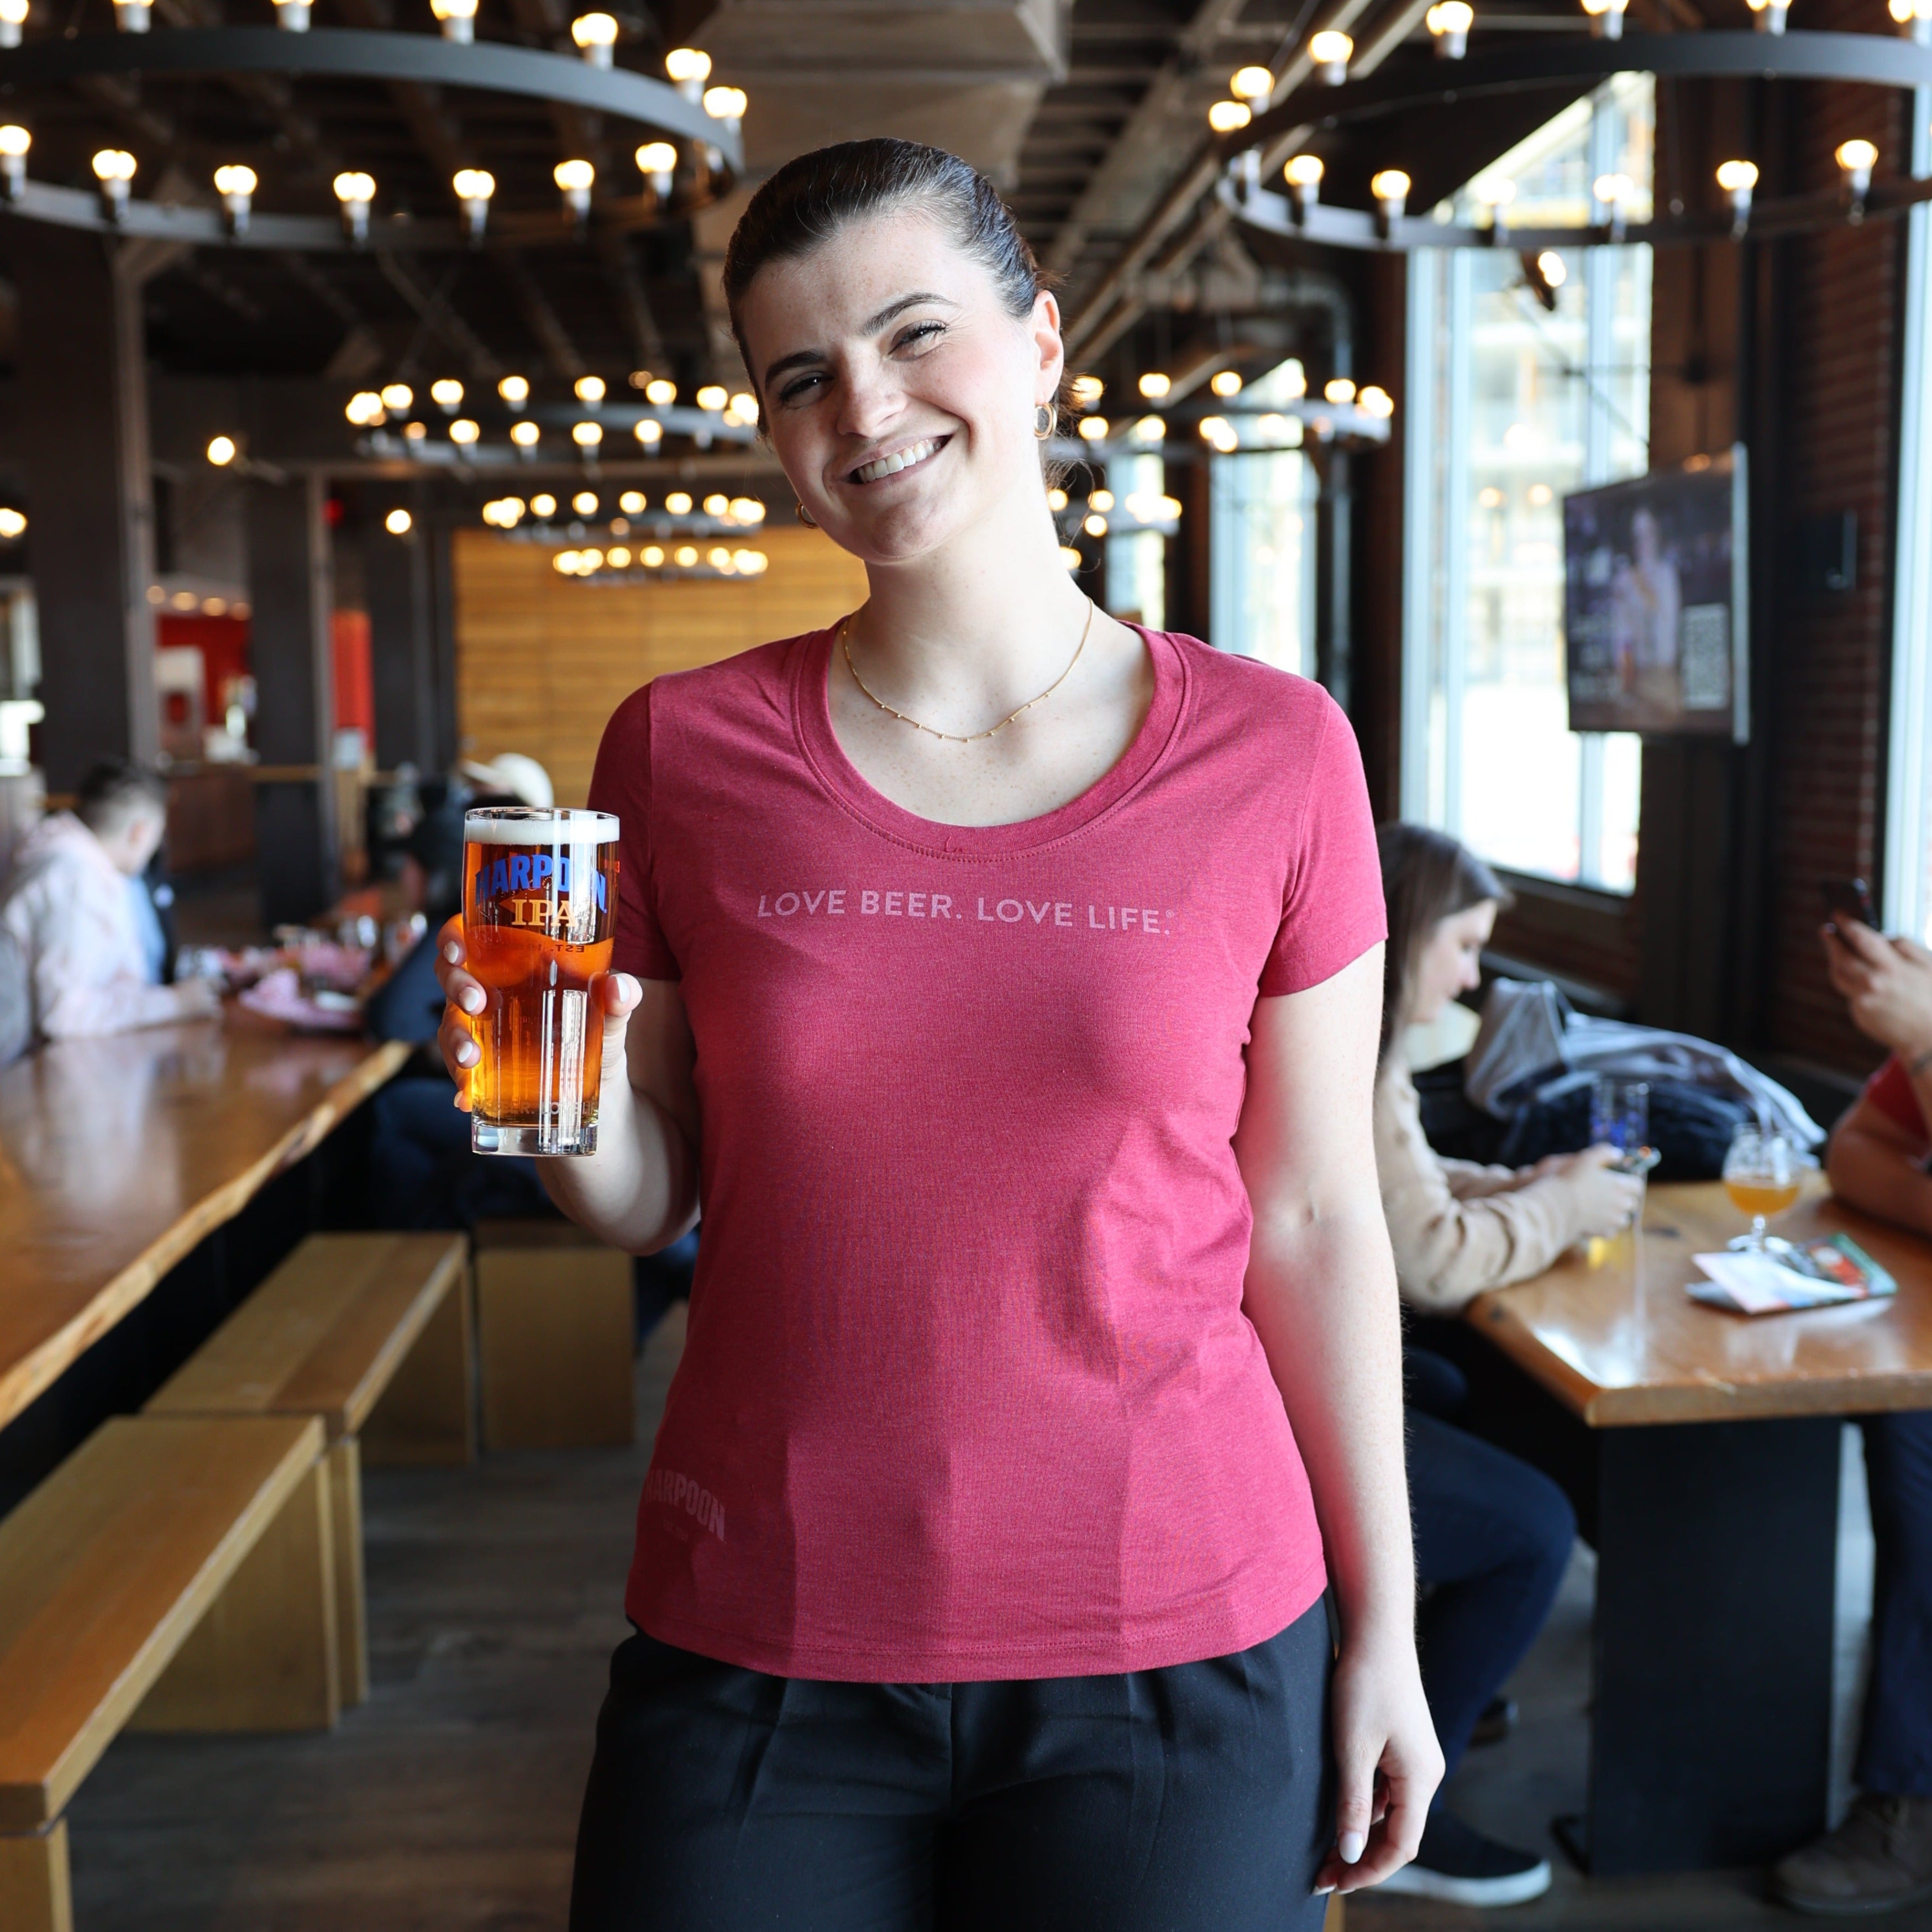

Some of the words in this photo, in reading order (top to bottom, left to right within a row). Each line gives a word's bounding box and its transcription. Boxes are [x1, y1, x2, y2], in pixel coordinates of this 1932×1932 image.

[475, 854, 606, 912] HARPON
[511, 899, 578, 927] IPA
[757, 890, 847, 917] LOVE
[860, 890, 962, 920] BEER.
[978, 897, 1073, 925] LOVE
